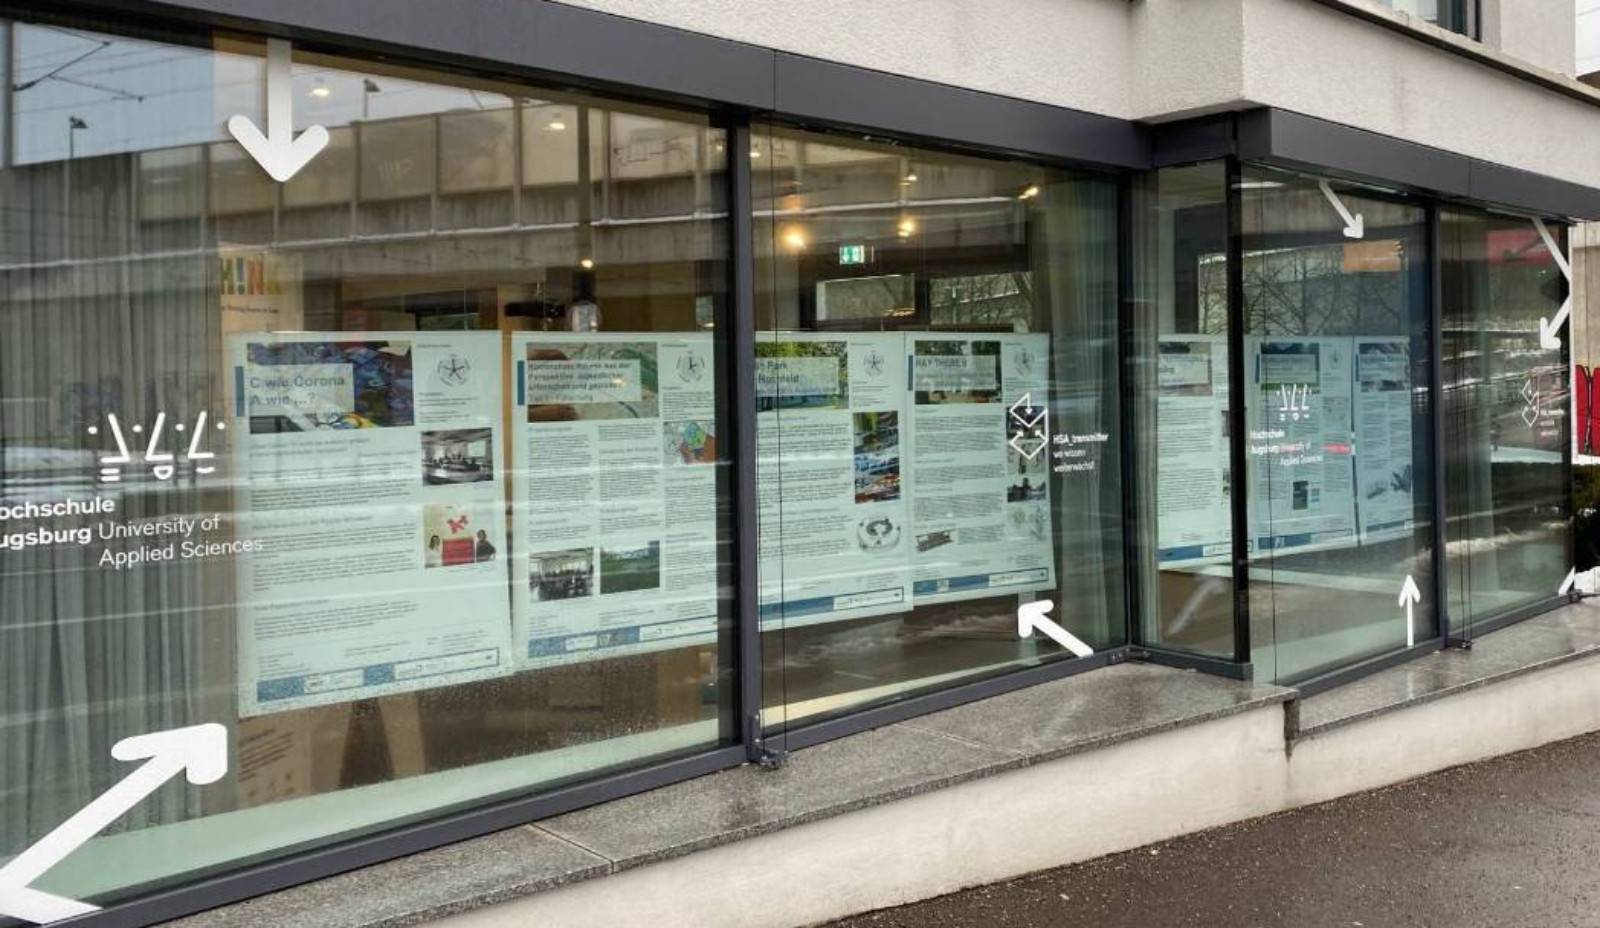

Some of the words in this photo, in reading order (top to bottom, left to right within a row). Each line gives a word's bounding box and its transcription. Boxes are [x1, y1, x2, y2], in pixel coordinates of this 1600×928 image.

[293, 374, 346, 388] Corona
[99, 517, 195, 540] University
[200, 513, 221, 532] of
[99, 542, 174, 570] Applied
[180, 538, 264, 559] Sciences
